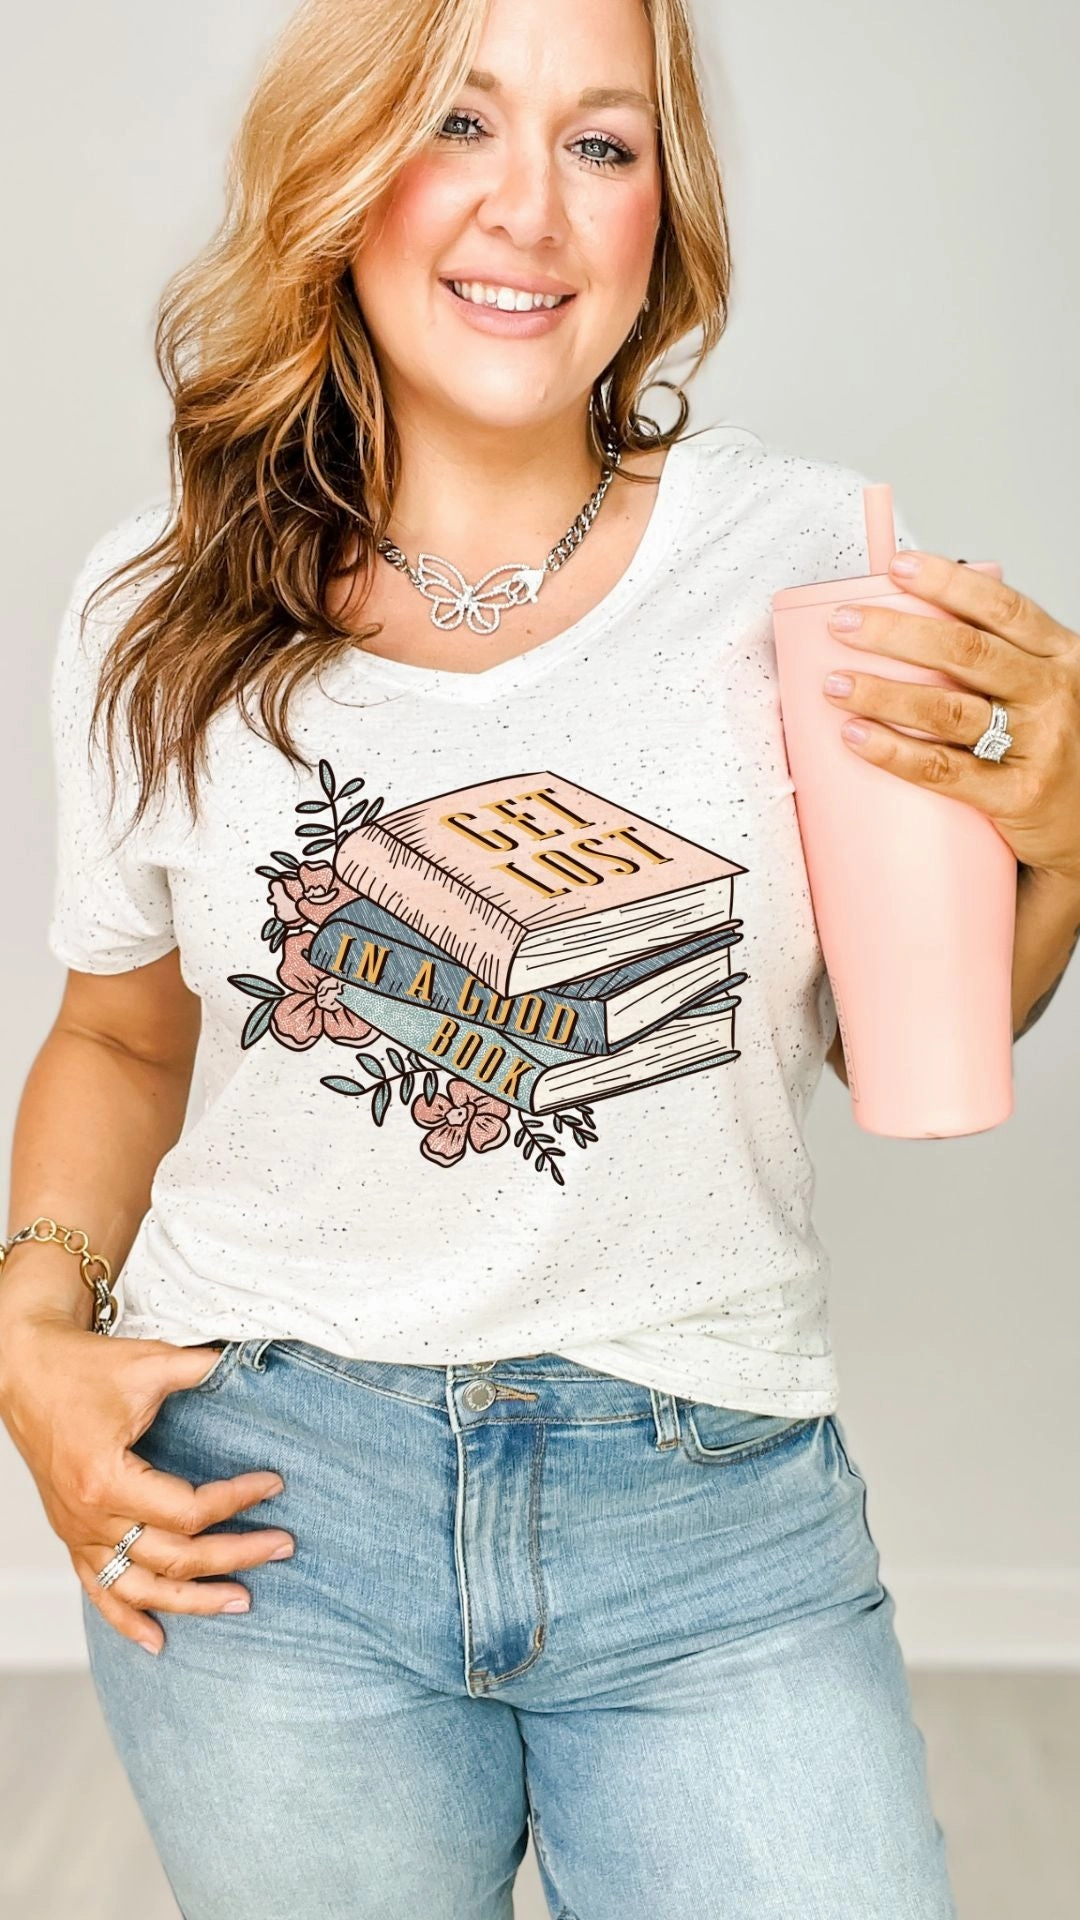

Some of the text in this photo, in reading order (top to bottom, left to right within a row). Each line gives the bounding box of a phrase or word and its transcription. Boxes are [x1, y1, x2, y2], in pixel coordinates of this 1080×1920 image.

[439, 787, 596, 851] GET
[490, 826, 674, 899] LOST
[331, 933, 579, 1045] IN A GOOD
[426, 1015, 536, 1099] BOOK
